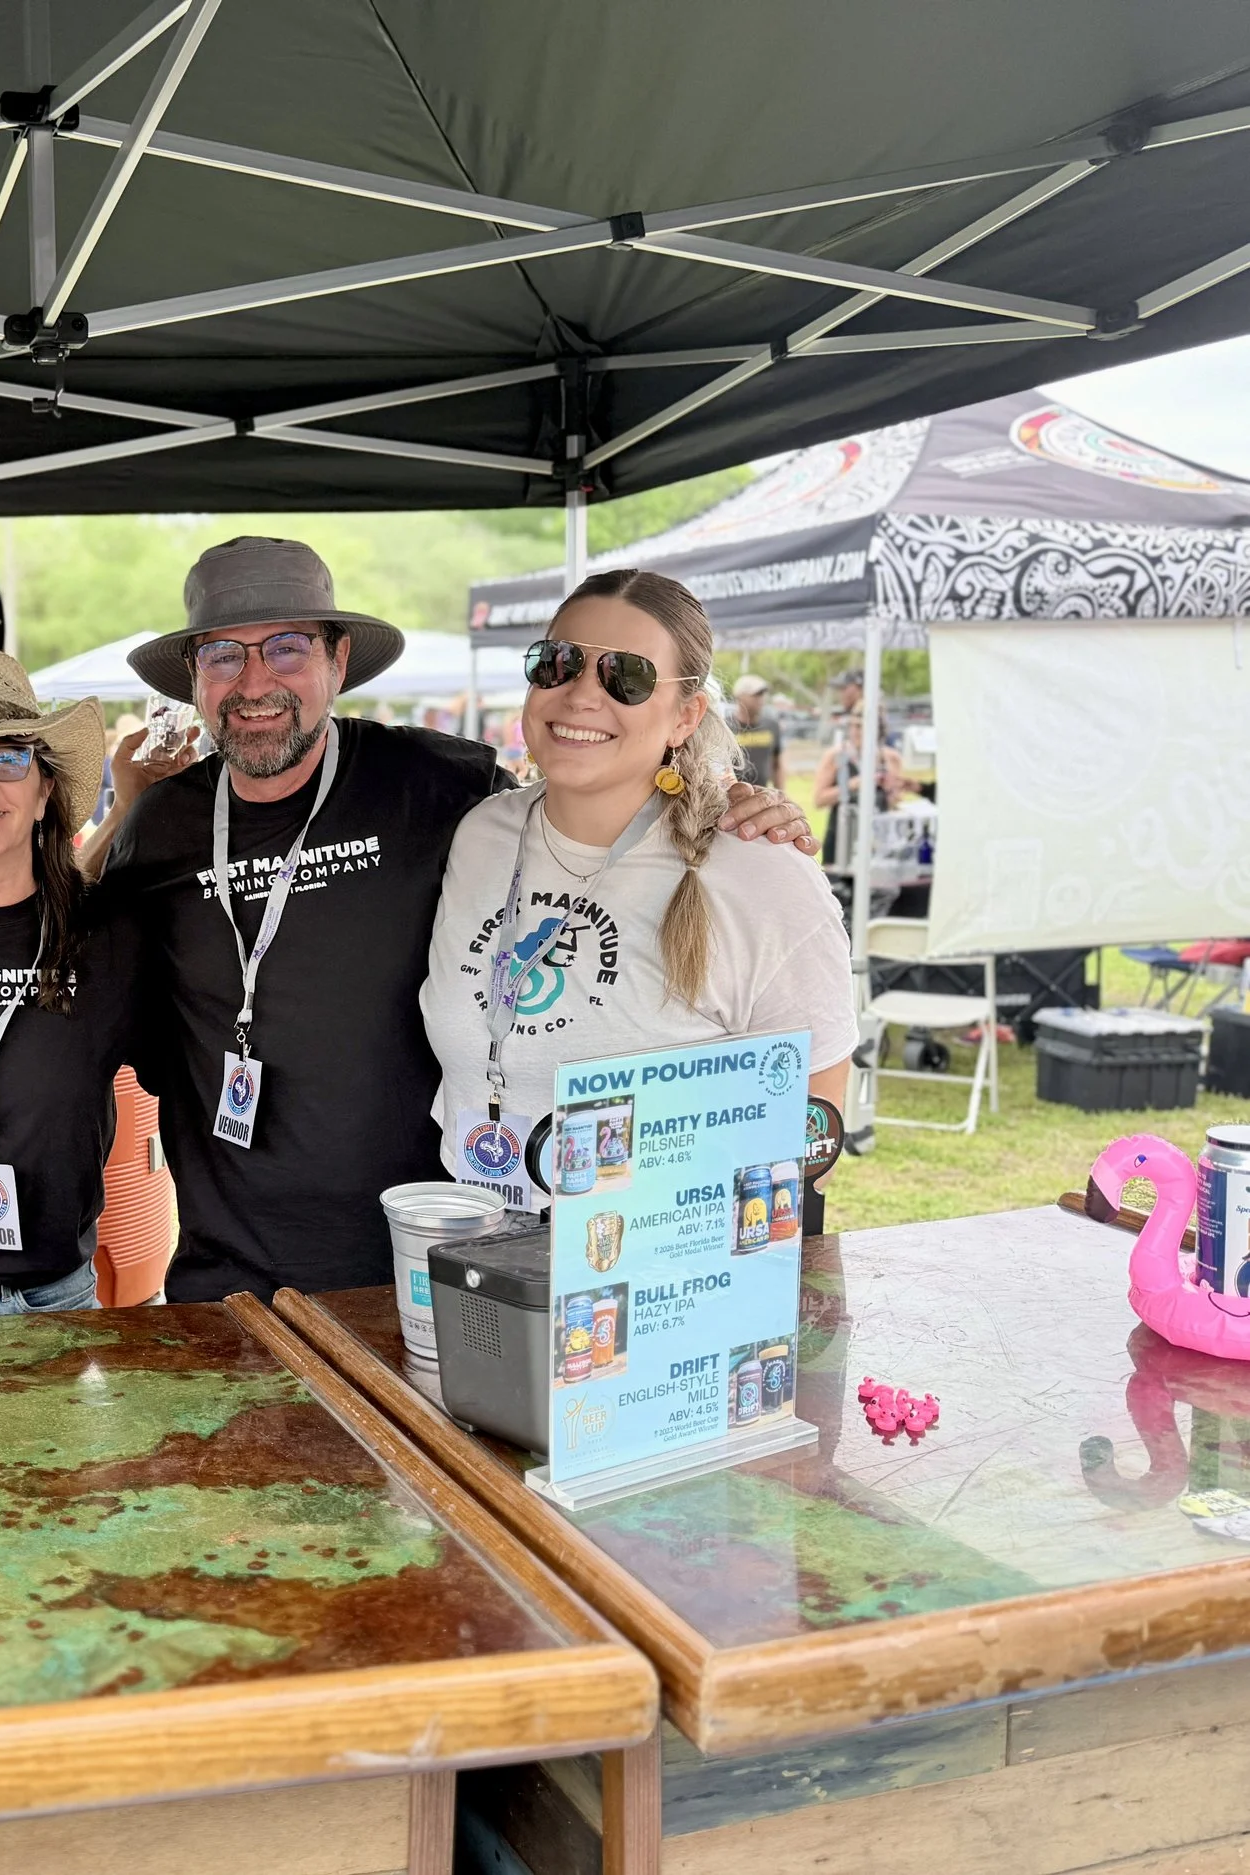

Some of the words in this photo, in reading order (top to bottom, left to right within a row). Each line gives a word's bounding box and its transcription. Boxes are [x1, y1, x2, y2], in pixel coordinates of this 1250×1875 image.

[196, 860, 249, 886] FIST
[252, 836, 380, 874] MANITUDE
[295, 881, 327, 893] FLORIDA
[469, 897, 522, 954] FIRS
[530, 892, 619, 985] MAGNITUDE
[460, 964, 481, 976] GNV
[589, 996, 604, 1006] FL
[474, 991, 537, 1035] BRING
[759, 1049, 771, 1076] FIRST
[771, 1041, 802, 1070] MAGNITUDE
[568, 1069, 635, 1097] NOW
[642, 1051, 757, 1086] POURING
[218, 1114, 250, 1142] VENDOR
[639, 1113, 702, 1139] PARTY
[706, 1103, 767, 1128] BARGE
[639, 1133, 695, 1154] PILSNER
[805, 1138, 835, 1158] IFT
[638, 1156, 666, 1170] ABV:
[667, 1152, 692, 1165] 4.6%
[461, 1179, 523, 1205] DOR
[676, 1184, 726, 1206] URSA
[629, 1206, 702, 1231] AMERICAN
[704, 1202, 725, 1217] IPA
[1236, 1205, 1250, 1213] Spe
[677, 1222, 703, 1236] ABV:
[705, 1217, 725, 1231] 7.1%
[739, 1222, 769, 1239] URSA
[669, 1250, 683, 1259] Gold
[685, 1247, 702, 1255] Medal
[703, 1243, 724, 1252] Winner
[676, 1242, 688, 1250] Best
[690, 1238, 710, 1247] Florida
[413, 1273, 430, 1288] FIR
[634, 1286, 678, 1306] BULL
[683, 1272, 731, 1298] FROG
[634, 1304, 672, 1321] HAZY
[675, 1298, 695, 1312] IPA
[633, 1323, 660, 1336] ABV:
[662, 1317, 685, 1330] 6.7%
[670, 1353, 720, 1379] DRIFT
[618, 1371, 720, 1406] ENGLISH-STYLE
[687, 1386, 719, 1404] MILD
[583, 1411, 607, 1425] BEER
[668, 1408, 694, 1423] ABV:
[696, 1401, 719, 1415] 4.5%
[585, 1422, 605, 1435] CUP
[675, 1422, 691, 1431] World
[692, 1418, 707, 1426] Beer
[707, 1416, 718, 1424] Cup
[663, 1433, 677, 1442] Gold
